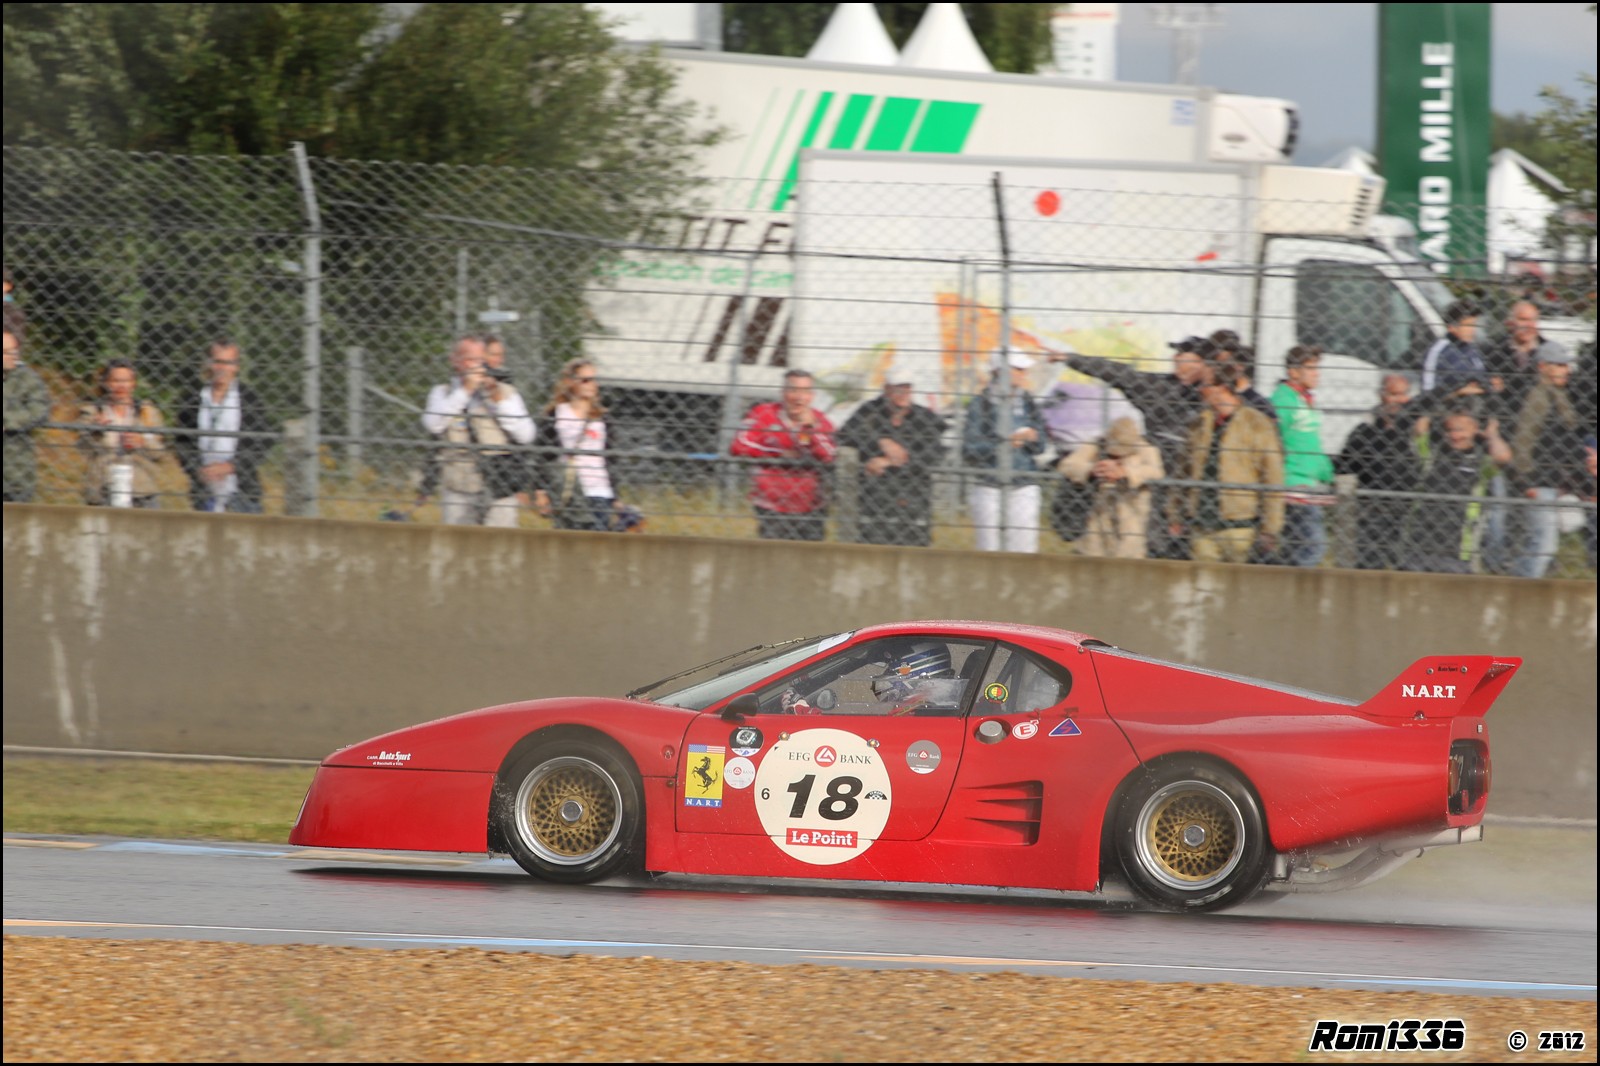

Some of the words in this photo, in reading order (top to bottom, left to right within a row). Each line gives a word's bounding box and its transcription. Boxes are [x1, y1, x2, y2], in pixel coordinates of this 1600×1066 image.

[1419, 42, 1454, 162] MILLE
[626, 212, 748, 254] ETIT
[1418, 176, 1452, 274] ARD
[1402, 684, 1456, 698] N.A.R.T.
[788, 752, 811, 761] EFG
[840, 754, 872, 764] BANK
[761, 788, 770, 800] 6
[786, 774, 863, 820] 18
[791, 830, 809, 844] Le
[811, 831, 853, 846] Point
